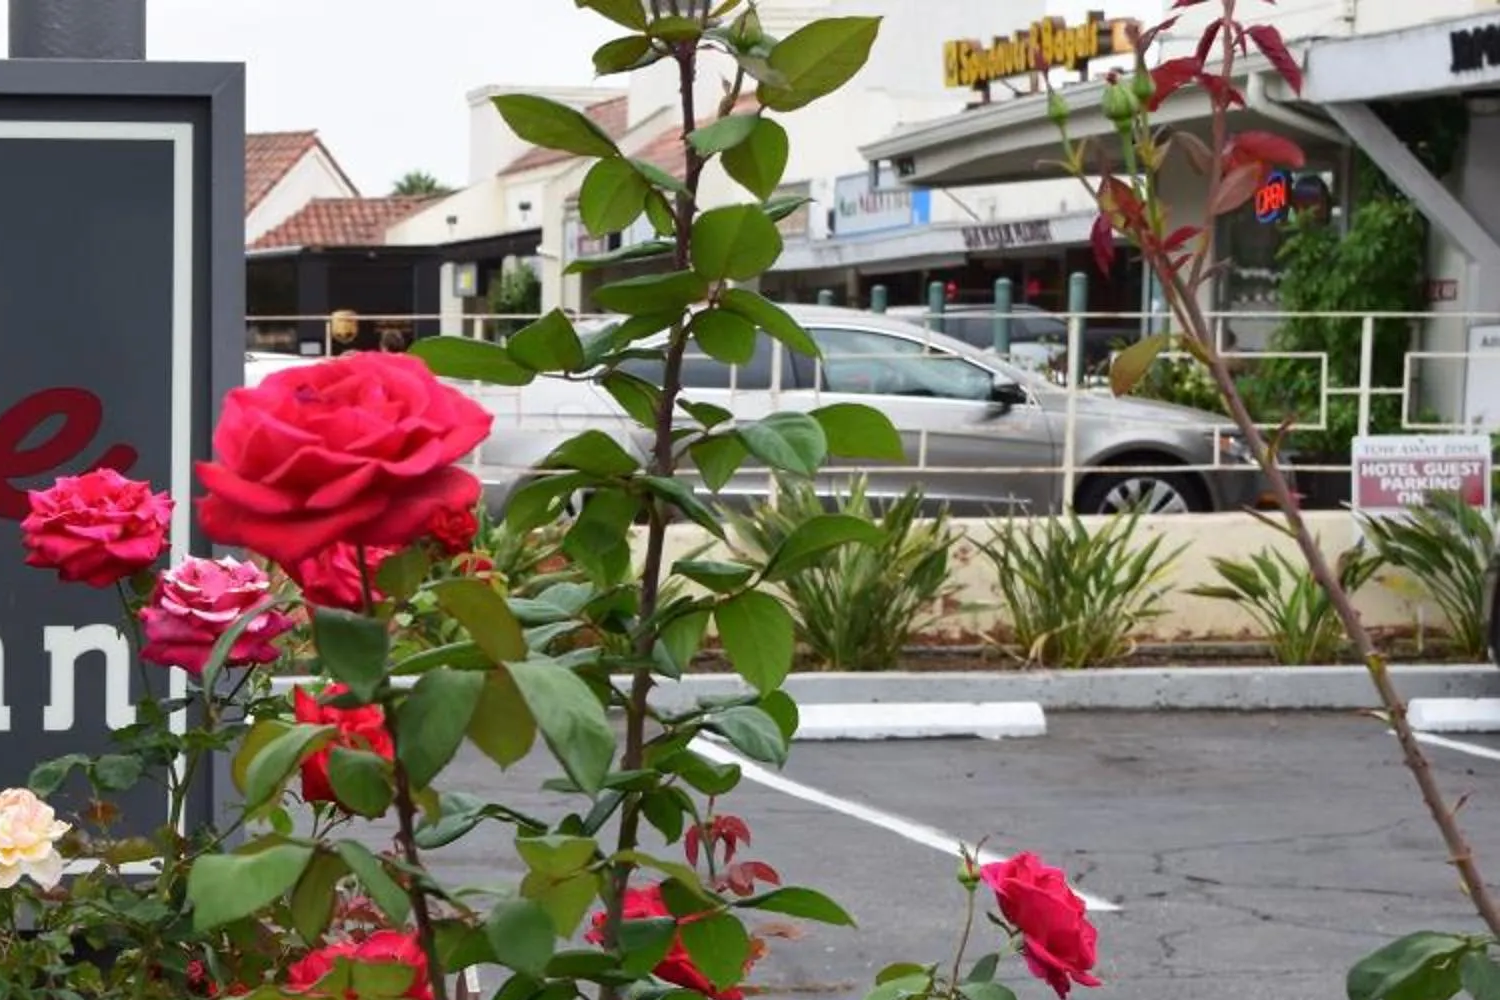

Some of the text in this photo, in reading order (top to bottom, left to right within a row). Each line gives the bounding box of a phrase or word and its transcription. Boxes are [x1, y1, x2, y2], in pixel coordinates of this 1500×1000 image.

[1255, 182, 1285, 217] OPEN
[1361, 461, 1482, 477] HOTEL GUEST
[1380, 477, 1462, 491] PARKING
